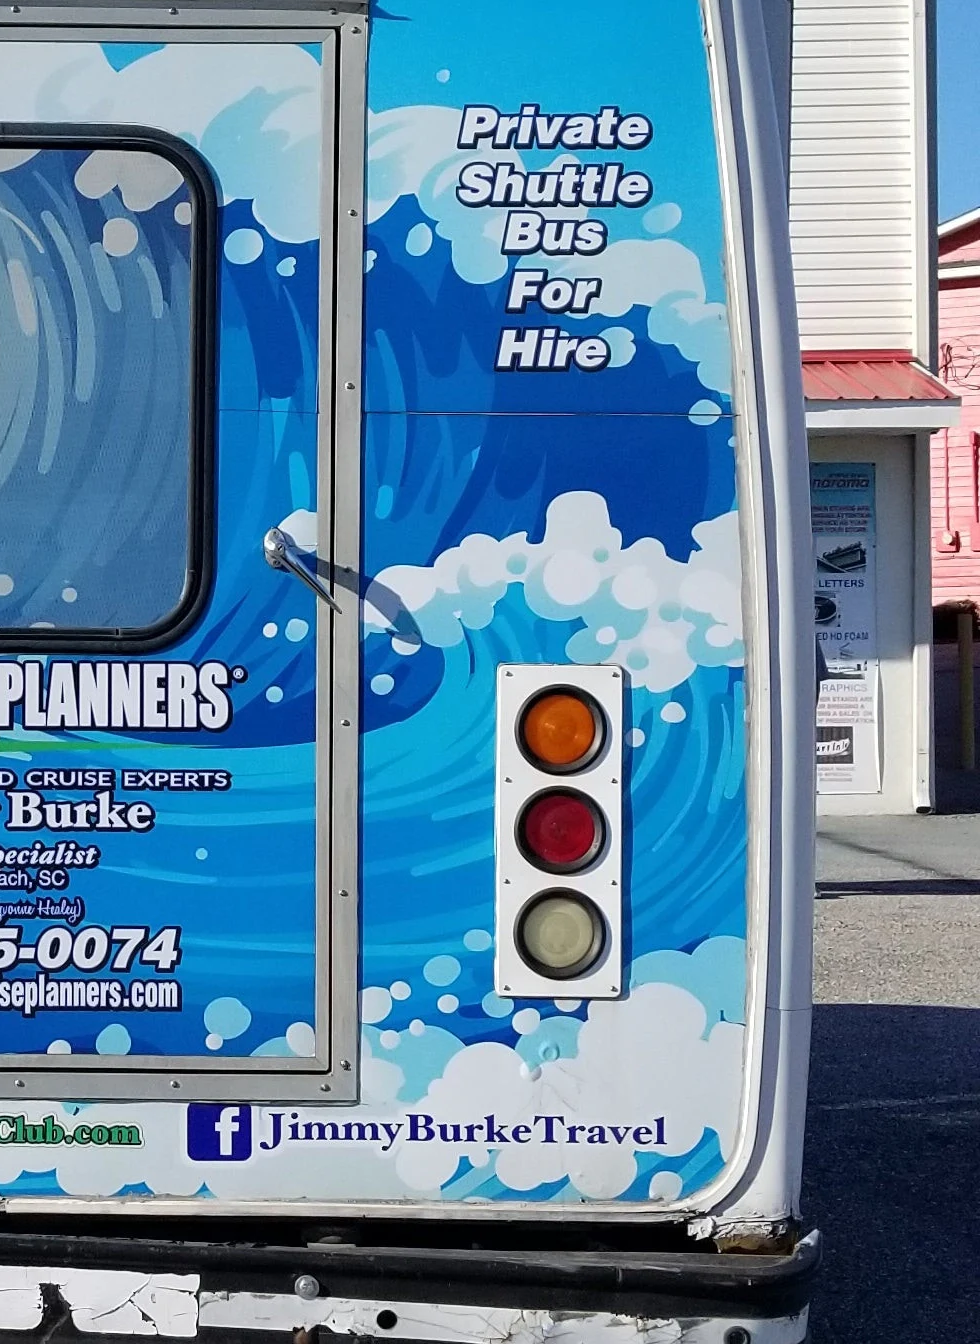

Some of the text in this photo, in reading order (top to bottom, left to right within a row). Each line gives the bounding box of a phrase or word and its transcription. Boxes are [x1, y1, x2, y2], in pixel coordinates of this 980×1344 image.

[458, 105, 652, 149] Private
[457, 163, 652, 206] Shuttle
[502, 211, 606, 254] Bus
[506, 269, 601, 313] For
[495, 327, 610, 372] Hire
[818, 579, 865, 588] LETTERS
[25, 771, 113, 787] CRUISE
[123, 771, 228, 788] EXPERTS
[6, 790, 152, 829] Burke
[38, 869, 66, 887] SC
[37, 897, 82, 923] Healey)
[260, 1112, 668, 1152] JimmyBurkeTravel
